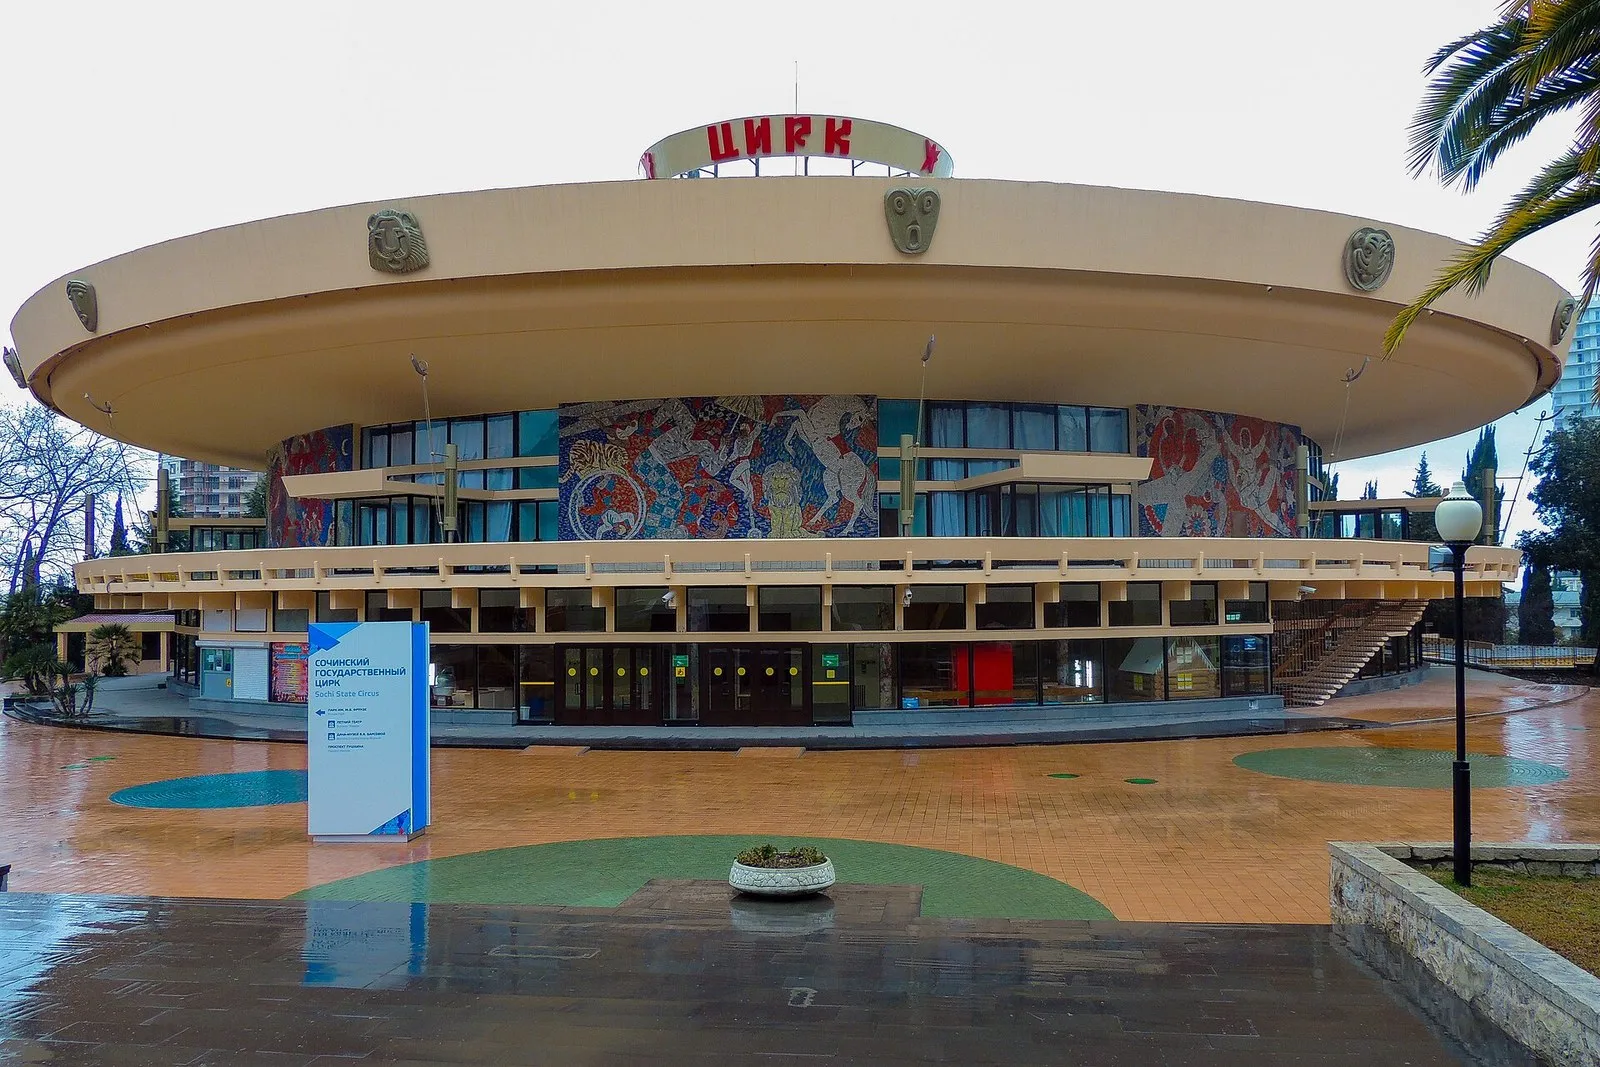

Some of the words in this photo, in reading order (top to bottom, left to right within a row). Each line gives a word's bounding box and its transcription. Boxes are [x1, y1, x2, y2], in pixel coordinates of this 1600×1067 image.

[707, 116, 852, 161] ЦИРК
[315, 657, 370, 667] СОЧИНСКИЙ
[315, 667, 406, 677] ГОСУДАРСТВЕННЫЙ
[315, 679, 341, 688] ЦИРК
[315, 690, 335, 698] Sochi
[336, 690, 357, 698] State
[357, 689, 380, 697] Circus
